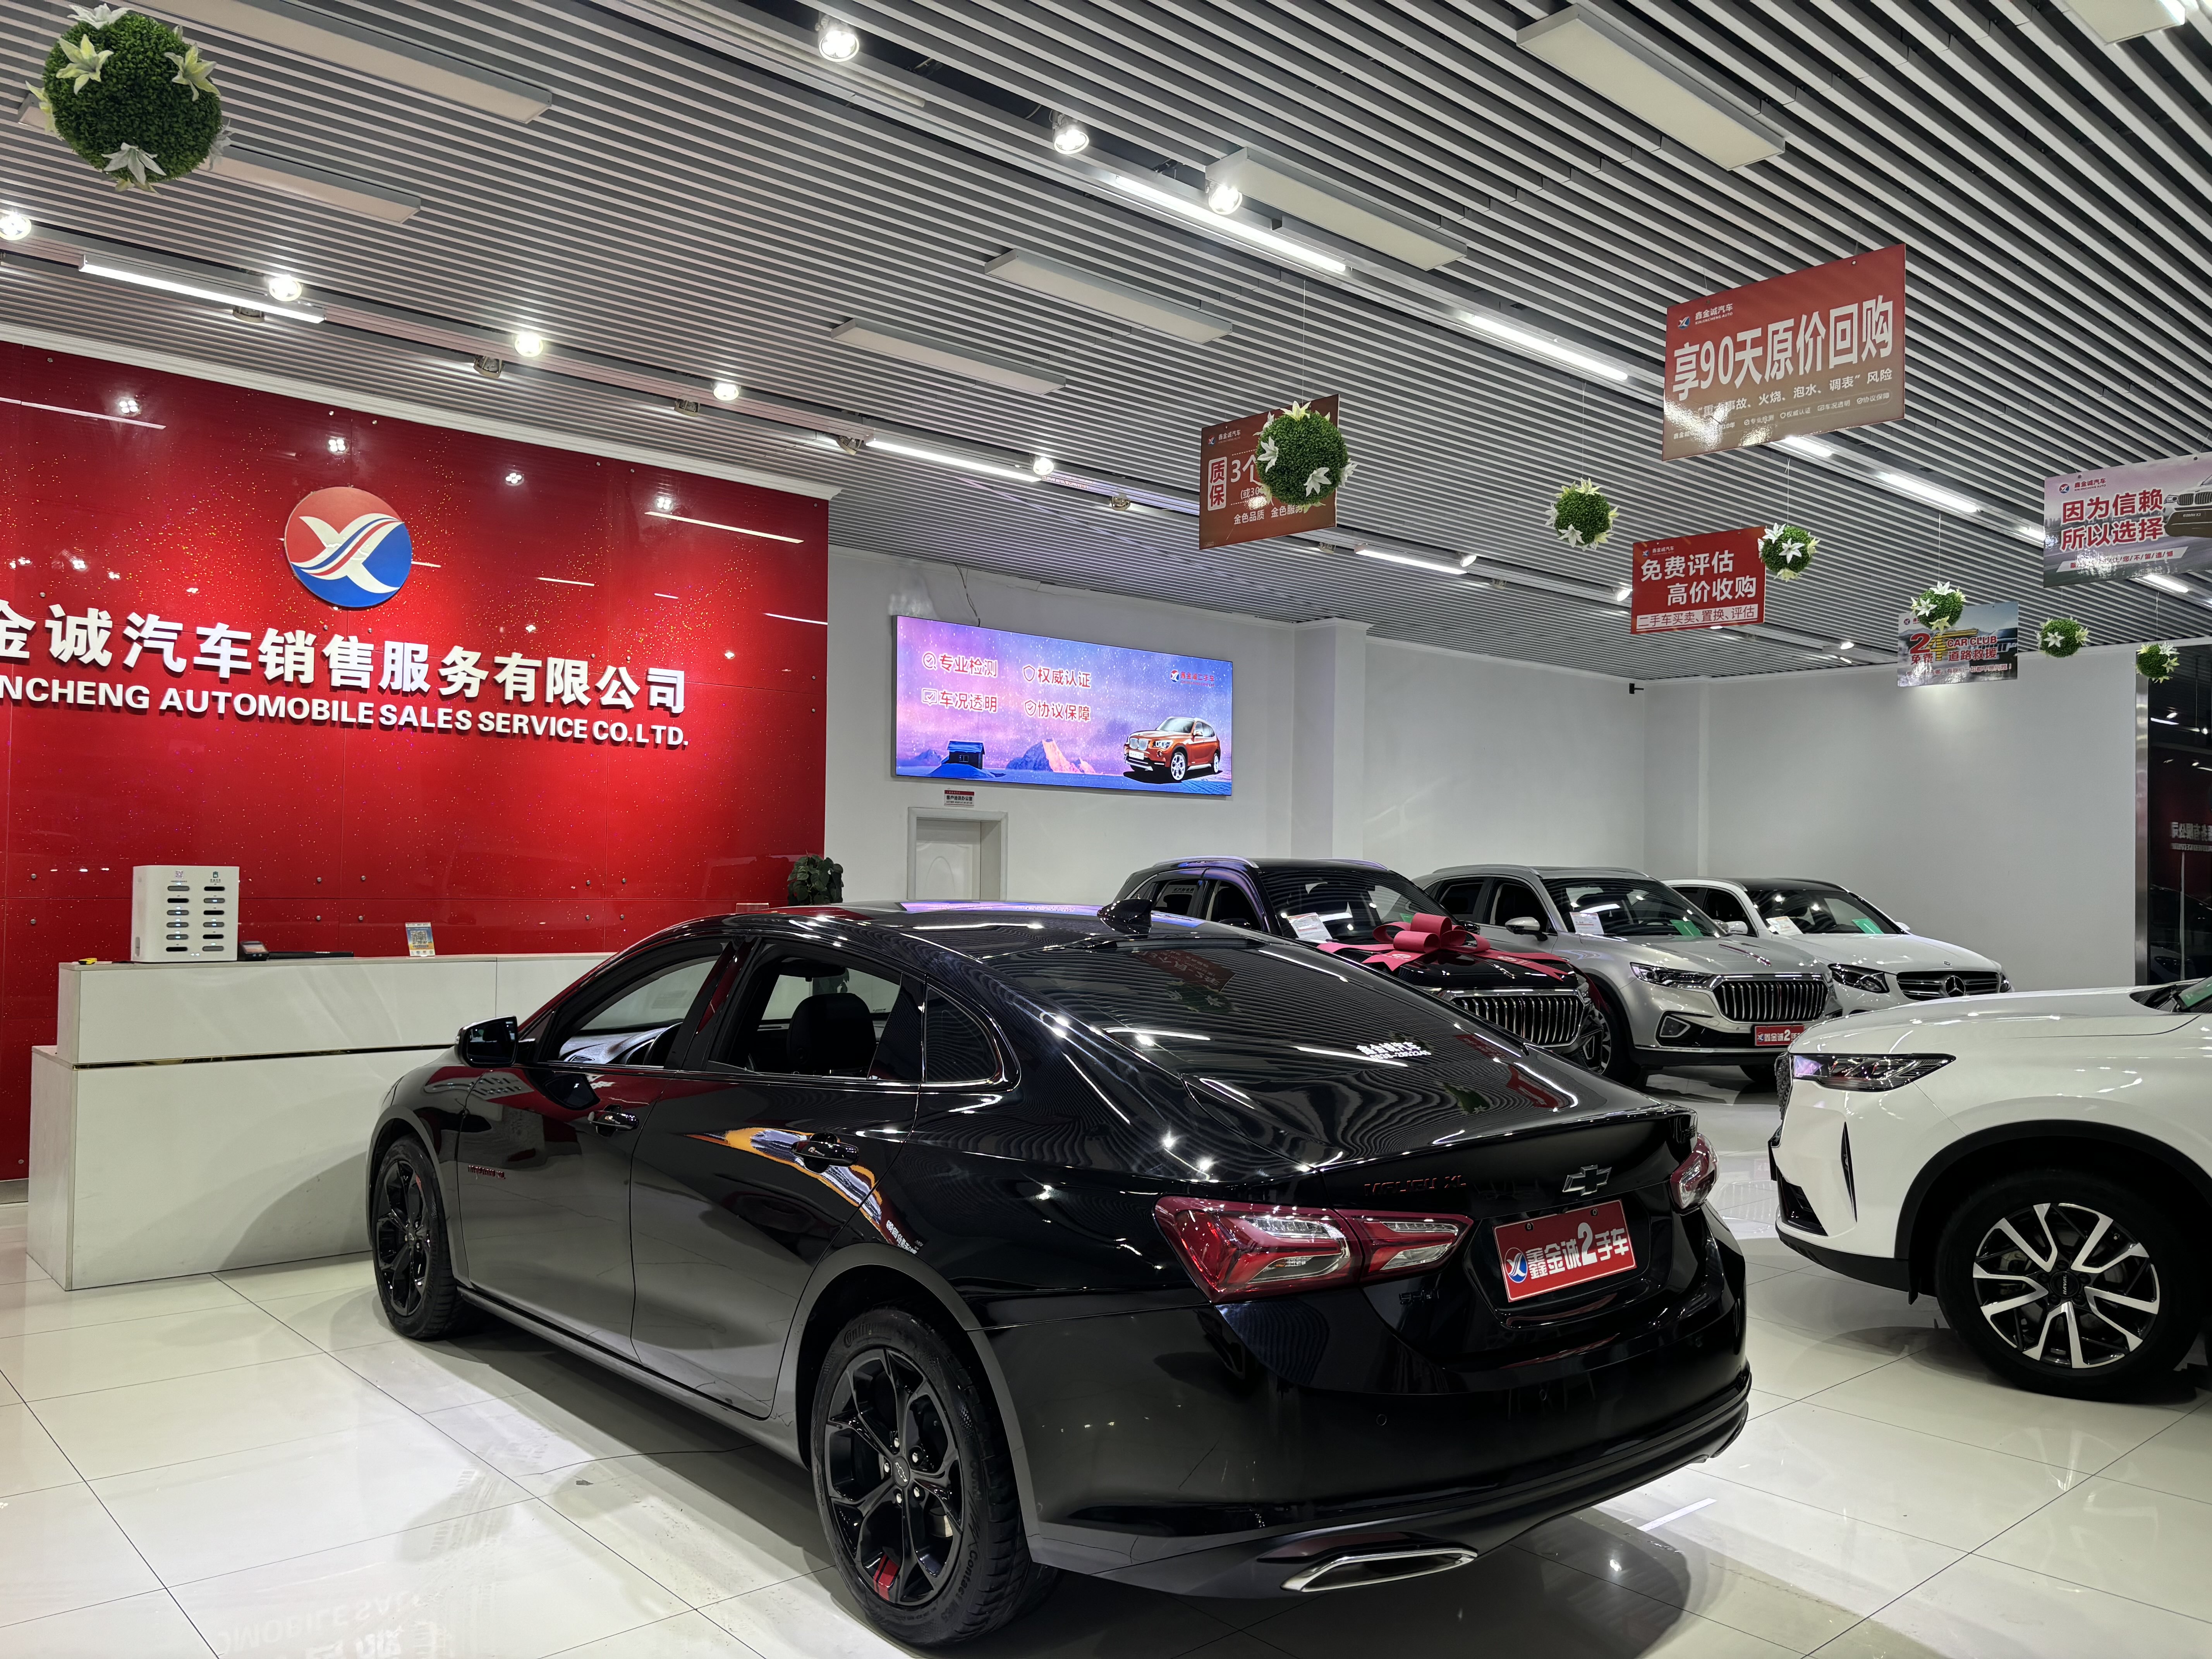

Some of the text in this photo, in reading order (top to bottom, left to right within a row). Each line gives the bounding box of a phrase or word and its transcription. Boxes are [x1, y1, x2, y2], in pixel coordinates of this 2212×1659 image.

[1695, 303, 1733, 321] 鑫金诚汽车
[1672, 295, 1893, 402] 享90天原价回购
[1209, 460, 1225, 507] 质保
[1234, 510, 1264, 524] 金色品质
[2062, 488, 2163, 524] 因为信赖
[2061, 517, 2164, 551] 所以选择
[1641, 550, 1735, 582] 免费评估
[1667, 575, 1757, 606] 高价收购
[1638, 606, 1755, 627] 二手车买卖、置换、评估
[1947, 635, 1998, 647] CAR CLUB
[0, 599, 685, 714] 金诚汽车销售服务有限公司
[939, 654, 997, 677] 专业检测
[1948, 648, 1997, 662] 道路救援
[1038, 666, 1091, 688] 权威认证
[159, 688, 374, 724] AUTOMOBILE
[379, 704, 472, 730] SALES
[478, 711, 588, 738] SERVICE
[939, 690, 997, 713] 车况透明
[1038, 701, 1090, 721] 协议保障
[1764, 1029, 1800, 1042] 鑫金诚2手
[1526, 1222, 1628, 1279] 鑫金诚2手车
